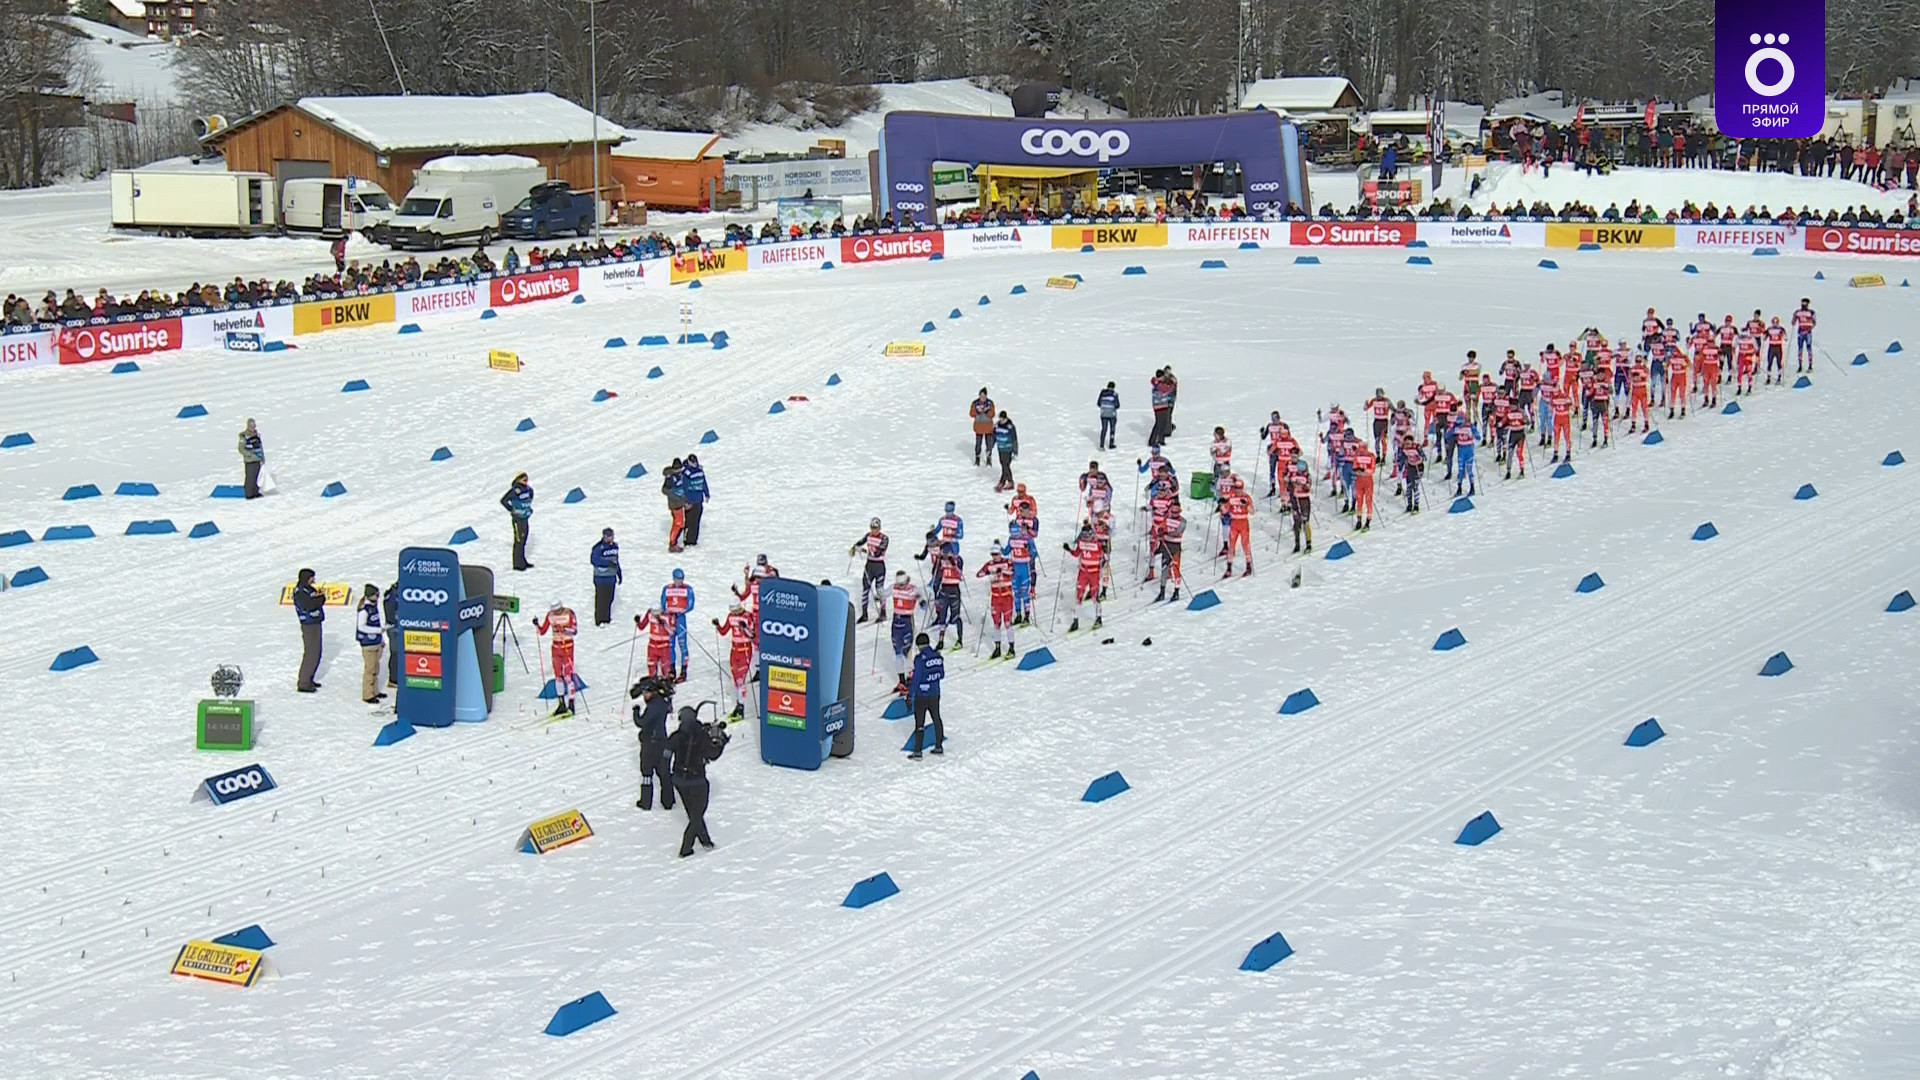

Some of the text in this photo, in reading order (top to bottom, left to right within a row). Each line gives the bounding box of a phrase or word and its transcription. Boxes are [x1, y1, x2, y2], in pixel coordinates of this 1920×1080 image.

[1021, 128, 1130, 163] coop
[896, 182, 924, 193] coop
[1250, 182, 1280, 192] coop
[1376, 190, 1411, 199] SPORT
[896, 201, 925, 212] coop
[972, 231, 1009, 243] helvetia
[1097, 229, 1138, 243] BKW
[1188, 228, 1270, 241] RAIFFEISEN
[1330, 225, 1400, 242] Sunrise
[1451, 226, 1497, 237] helvetia
[1597, 229, 1643, 244] BKW
[1697, 230, 1785, 245] RAIFFEISEN
[873, 236, 932, 257] Sunrise
[1848, 232, 1920, 252] Sunrise
[762, 245, 825, 264] RAIFFEISEN
[603, 267, 635, 280] helvetia
[518, 274, 569, 299] Sunrise
[412, 289, 476, 314] RAIFFEISEN
[335, 303, 370, 324] BKW
[213, 317, 253, 331] helvetia
[100, 325, 168, 354] Sunrise
[229, 340, 259, 351] coop
[402, 588, 449, 606] coop
[776, 592, 799, 601] CROSS
[776, 599, 807, 609] COUNTRY
[459, 604, 484, 621] coop
[399, 619, 431, 628] GOMS.CH
[762, 620, 809, 641] coop
[761, 652, 792, 664] GOMS.CH
[926, 658, 943, 667] coop
[826, 719, 844, 733] coop
[215, 770, 263, 795] coop
[534, 826, 545, 839] LE
[185, 945, 197, 960] LE
[183, 961, 233, 974] SWITZERLAND
